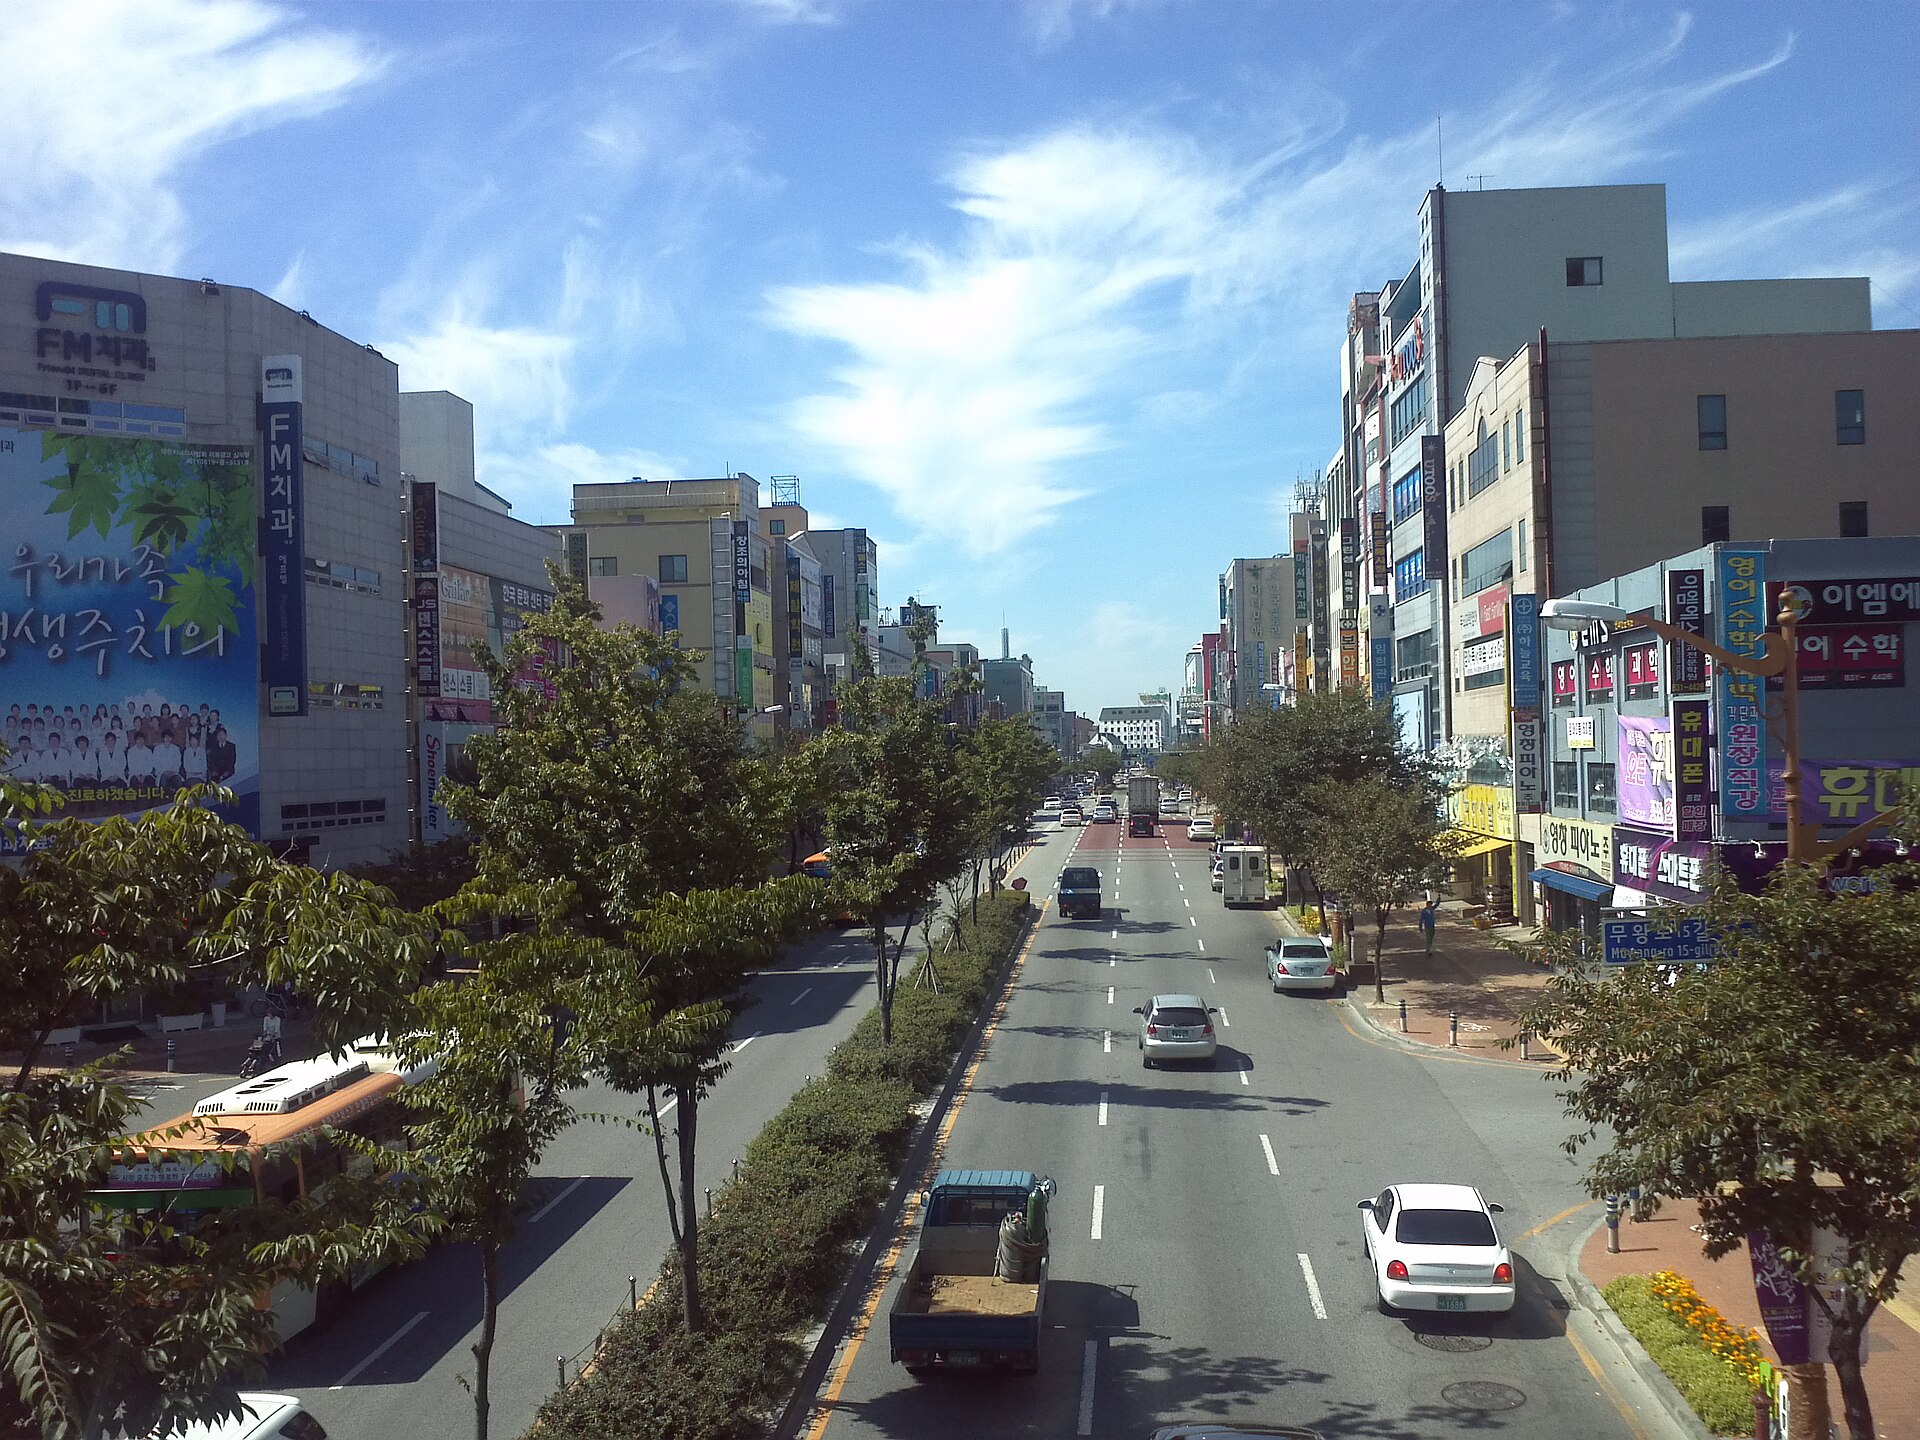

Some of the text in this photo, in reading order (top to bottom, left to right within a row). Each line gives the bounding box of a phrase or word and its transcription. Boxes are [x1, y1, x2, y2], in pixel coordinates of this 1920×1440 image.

[37, 327, 148, 370] FM치과
[270, 413, 297, 538] FM치과
[1424, 459, 1436, 503] UTOOS
[8, 545, 166, 600] 우리가족
[441, 577, 470, 602] Guitar
[1344, 571, 1354, 602] 미술학원
[417, 600, 437, 609] JS
[503, 585, 516, 604] 한국
[517, 588, 530, 608] 문화
[531, 591, 543, 610] 센터
[1822, 582, 1920, 615] 이엠에
[418, 611, 432, 681] 댄스스쿨
[1727, 556, 1758, 702] 영어/수학/학
[1631, 648, 1660, 680] 과학
[1794, 633, 1900, 661] 어 수학
[443, 673, 457, 693] 댄스
[459, 675, 473, 695] 스쿨
[1376, 643, 1388, 698] 임희관비
[1591, 656, 1613, 687] 수학
[1727, 705, 1738, 721] 각
[1518, 723, 1538, 792] 영창피아노
[1680, 711, 1704, 784] 휴대폰
[425, 733, 441, 830] Shoemaker
[1727, 723, 1761, 811] 원장직강
[68, 785, 170, 802] 진료하겠습니다.
[1682, 805, 1707, 819] 할인
[1682, 819, 1707, 832] 매장
[1550, 821, 1568, 857] 영창
[1570, 824, 1600, 862] 피아노
[1619, 843, 1651, 880] 휴대폰
[1657, 850, 1702, 893] 스마트폰
[1677, 921, 1710, 943] 15길
